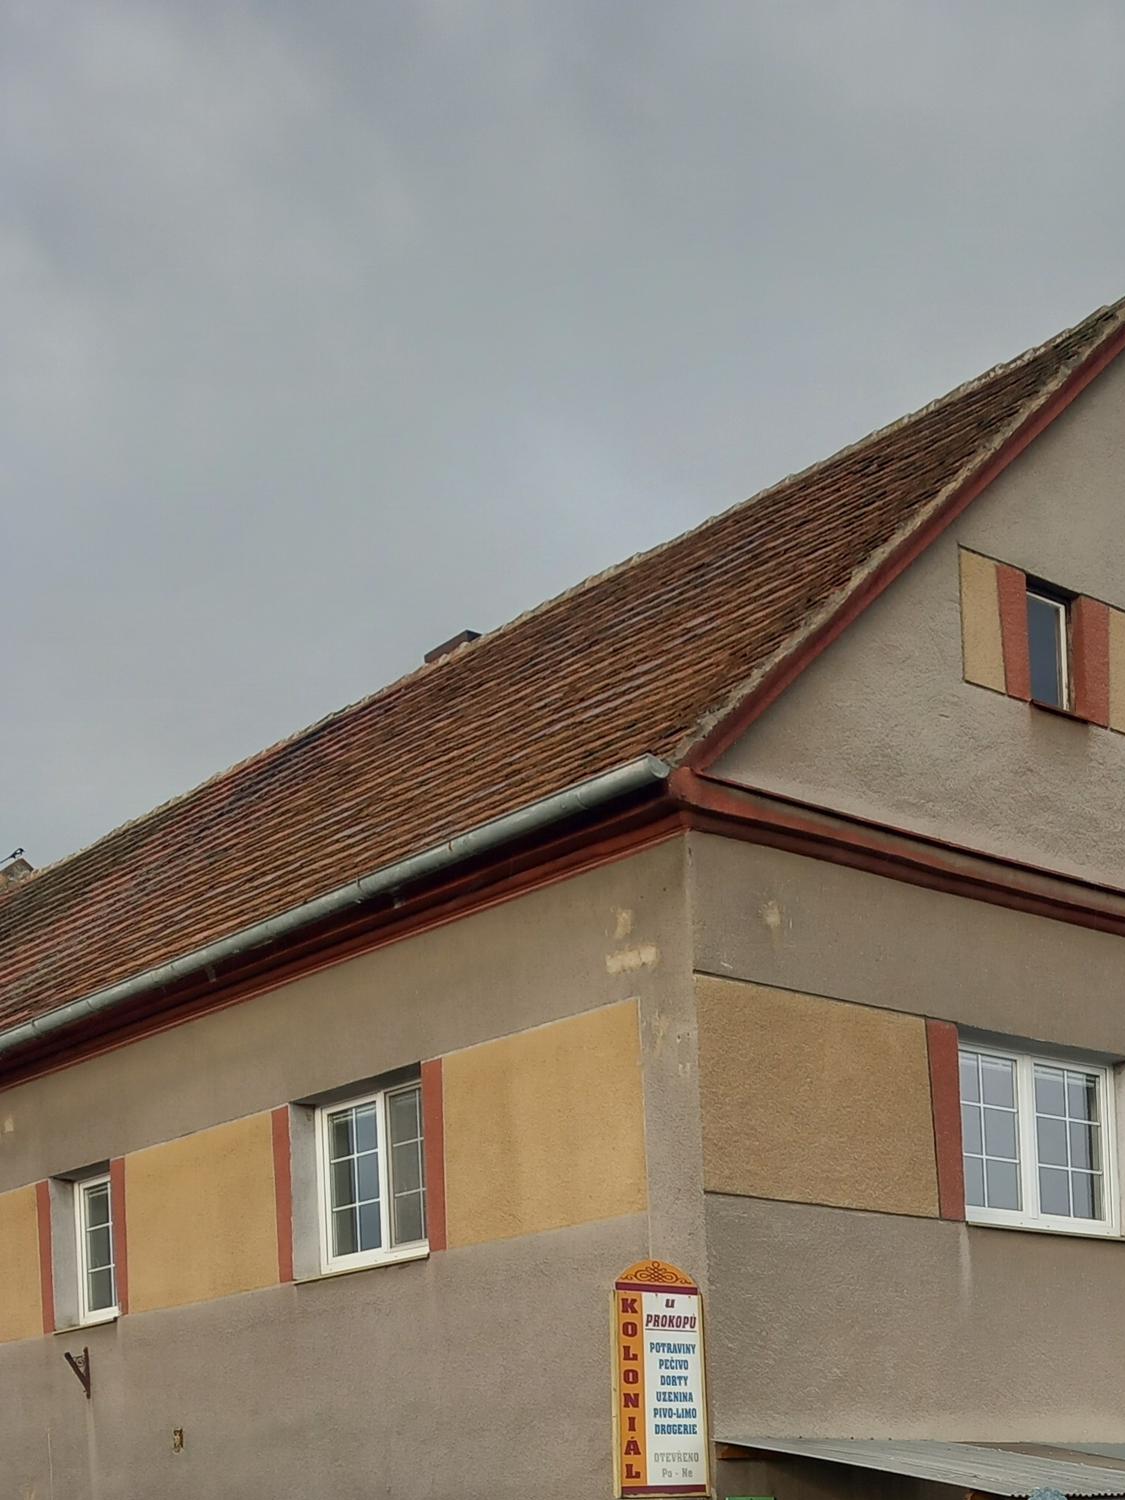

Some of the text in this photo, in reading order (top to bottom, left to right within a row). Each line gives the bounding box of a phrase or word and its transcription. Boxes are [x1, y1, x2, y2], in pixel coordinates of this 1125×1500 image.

[645, 1313, 697, 1329] PROKOPŮ
[649, 1342, 696, 1354] POTRAVINY
[658, 1357, 689, 1370] PEČIVO
[660, 1375, 688, 1387] DORTY
[620, 1298, 641, 1480] KOLONIÁL
[656, 1391, 694, 1403] UZENINA
[653, 1408, 697, 1419] PIVO-LIMO
[654, 1423, 698, 1435] DROGERIE
